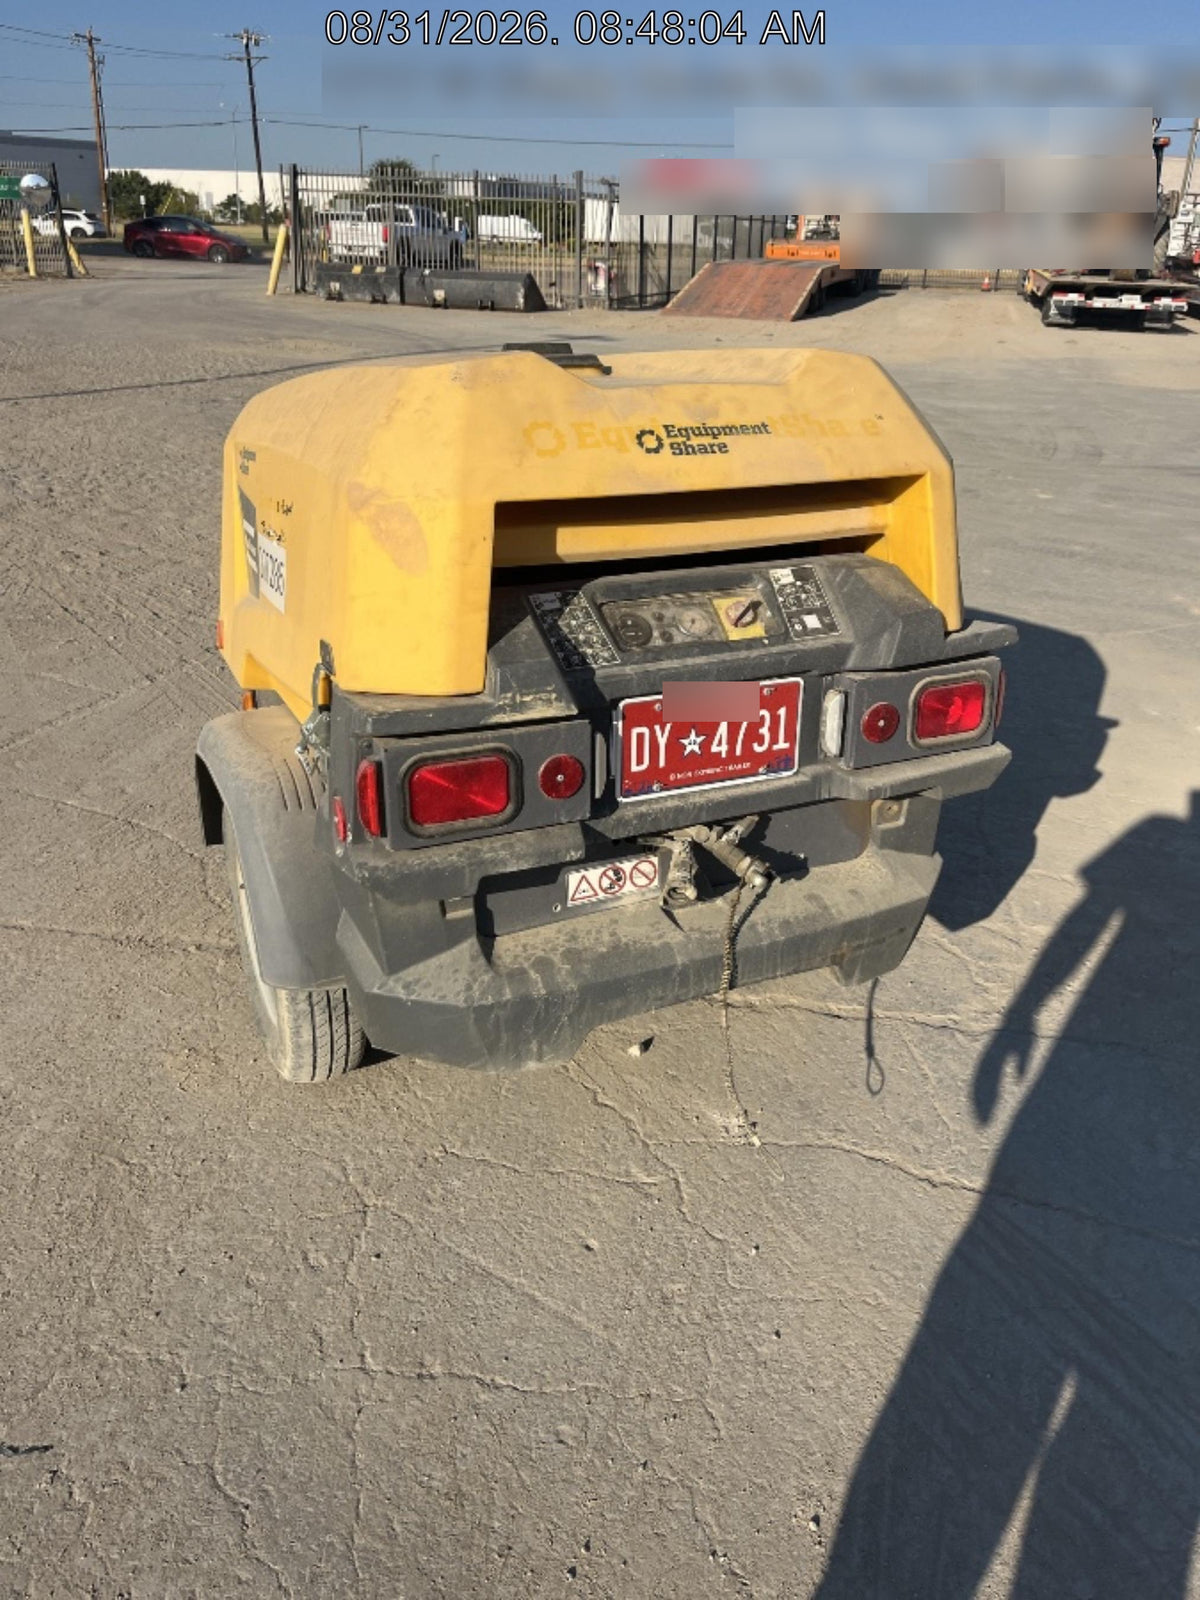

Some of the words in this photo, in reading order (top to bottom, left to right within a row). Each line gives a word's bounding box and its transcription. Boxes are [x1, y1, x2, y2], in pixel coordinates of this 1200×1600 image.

[663, 421, 773, 443] Equipment
[670, 440, 729, 456] Share
[630, 723, 672, 773] DY
